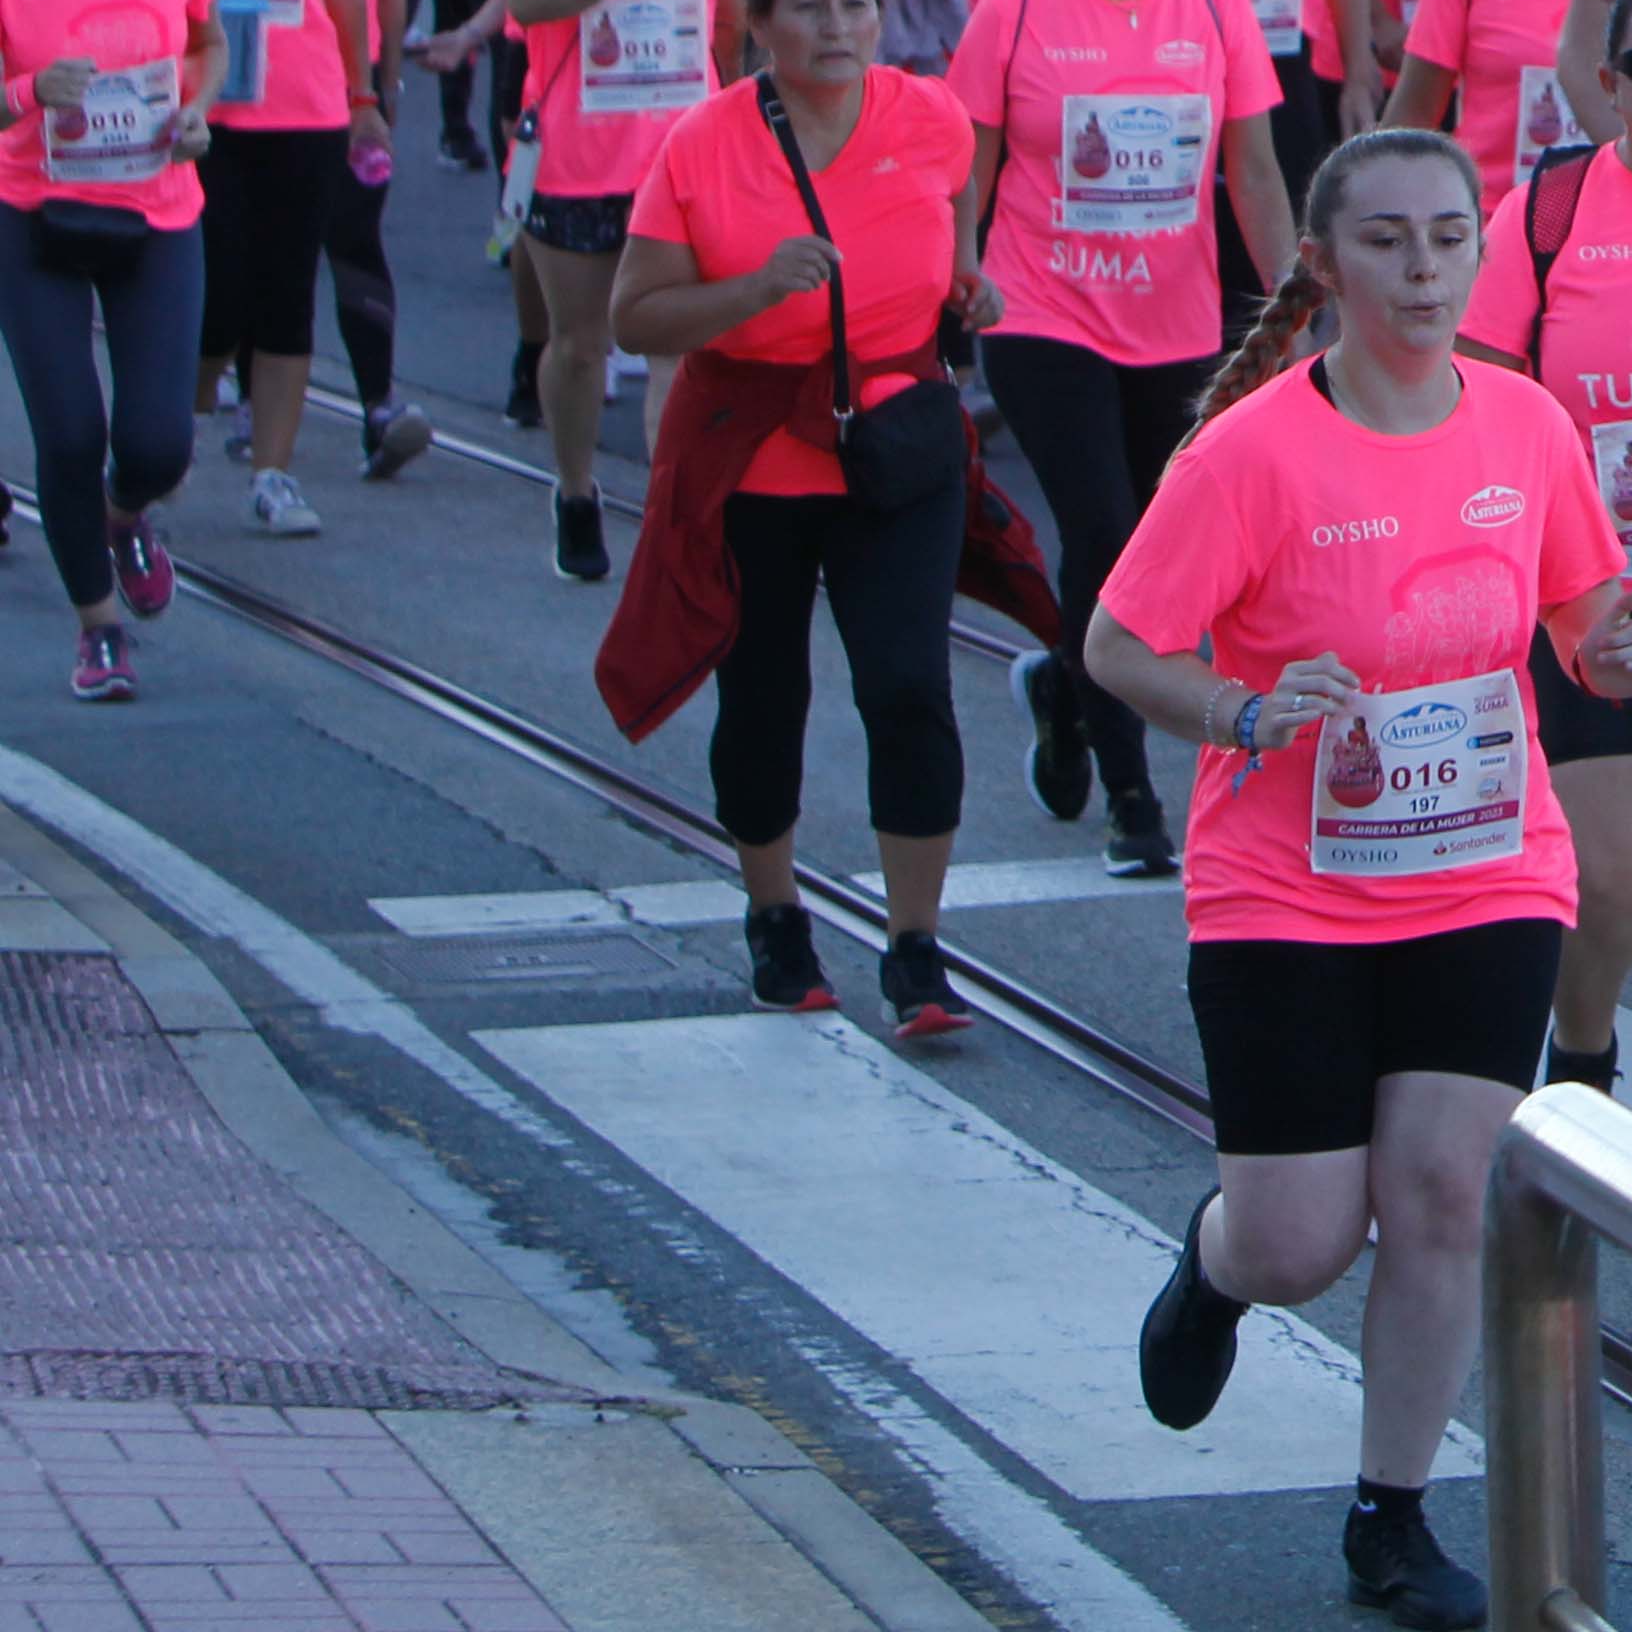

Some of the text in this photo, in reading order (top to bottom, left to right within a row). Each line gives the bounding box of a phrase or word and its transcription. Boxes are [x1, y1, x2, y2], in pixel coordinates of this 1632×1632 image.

[625, 39, 667, 60] 016
[1115, 149, 1164, 169] 016
[1051, 240, 1152, 283] SUMA
[1312, 515, 1399, 547] OYSHO
[1388, 719, 1460, 742] ASTURIANA
[1390, 759, 1458, 791] 016
[1409, 795, 1441, 814] 197
[1338, 821, 1399, 836] CARRERA
[1401, 820, 1418, 834] DE
[1419, 818, 1436, 832] LA
[1437, 812, 1476, 830] MUJER
[1331, 848, 1398, 864] OYSHO
